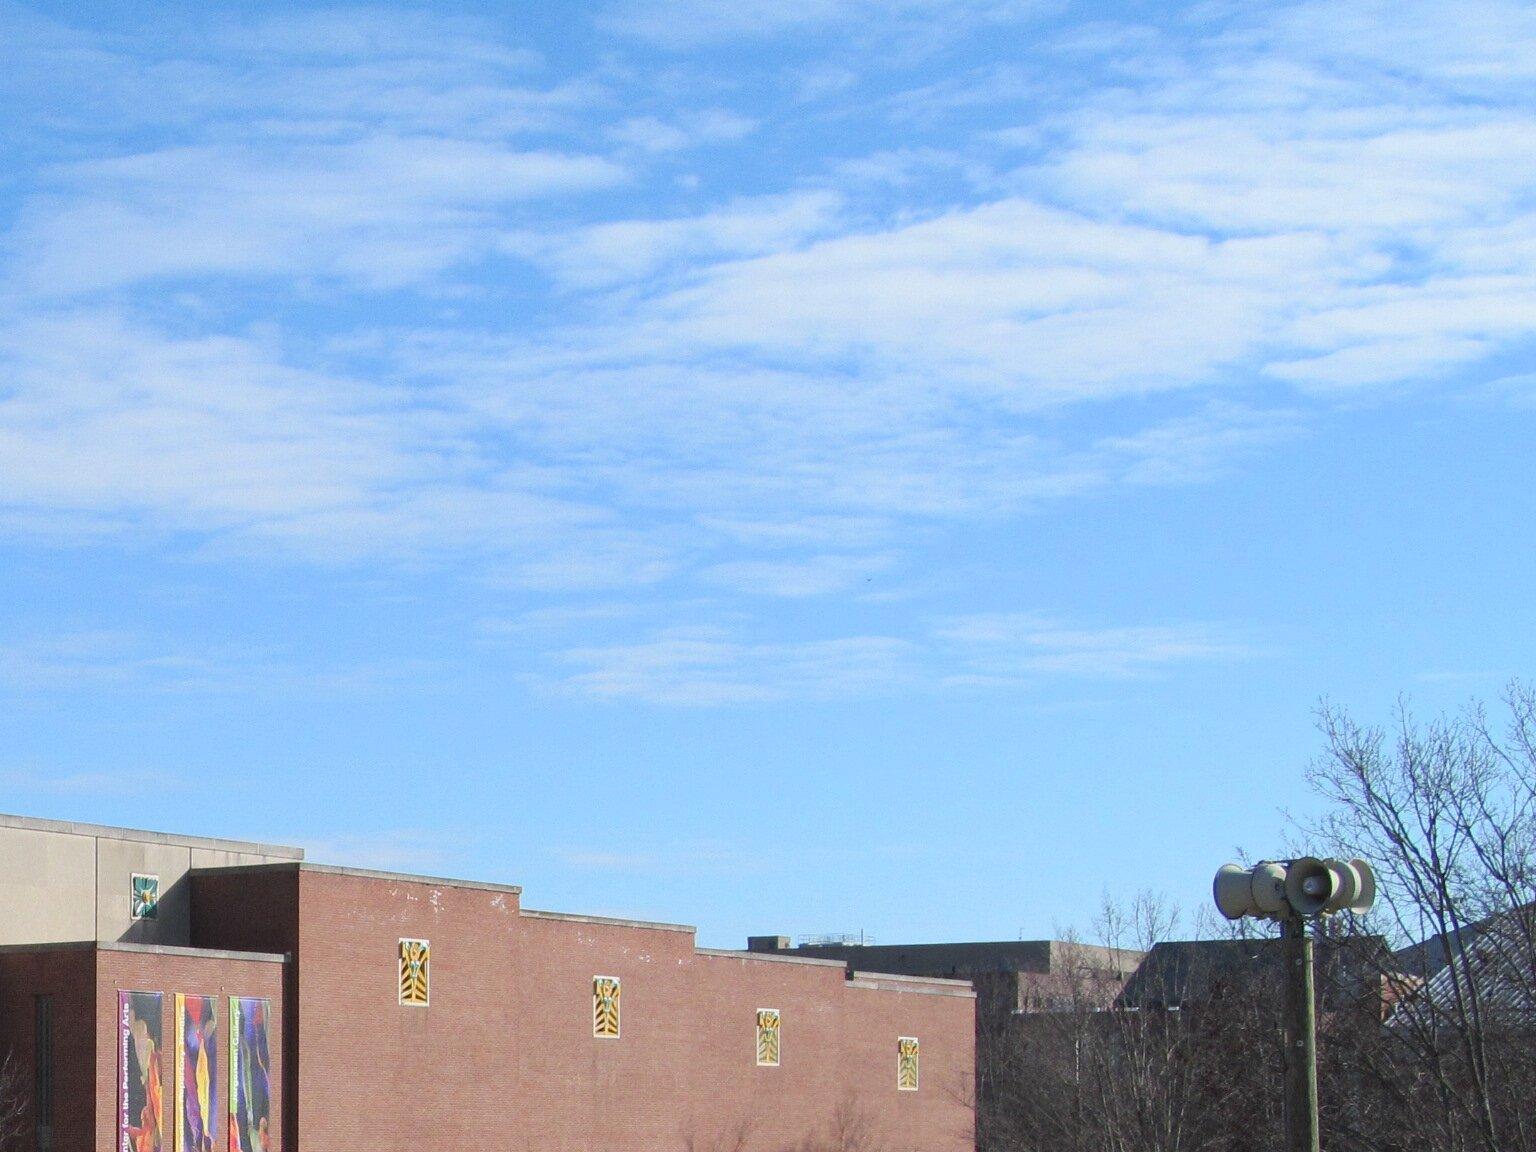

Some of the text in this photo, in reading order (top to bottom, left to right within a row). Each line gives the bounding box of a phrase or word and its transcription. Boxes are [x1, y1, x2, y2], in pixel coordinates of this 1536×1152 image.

[122, 1003, 130, 1026] Arts
[233, 1008, 241, 1045] Gallery
[122, 1029, 131, 1090] Performing
[122, 1093, 130, 1110] the
[122, 1112, 130, 1128] for
